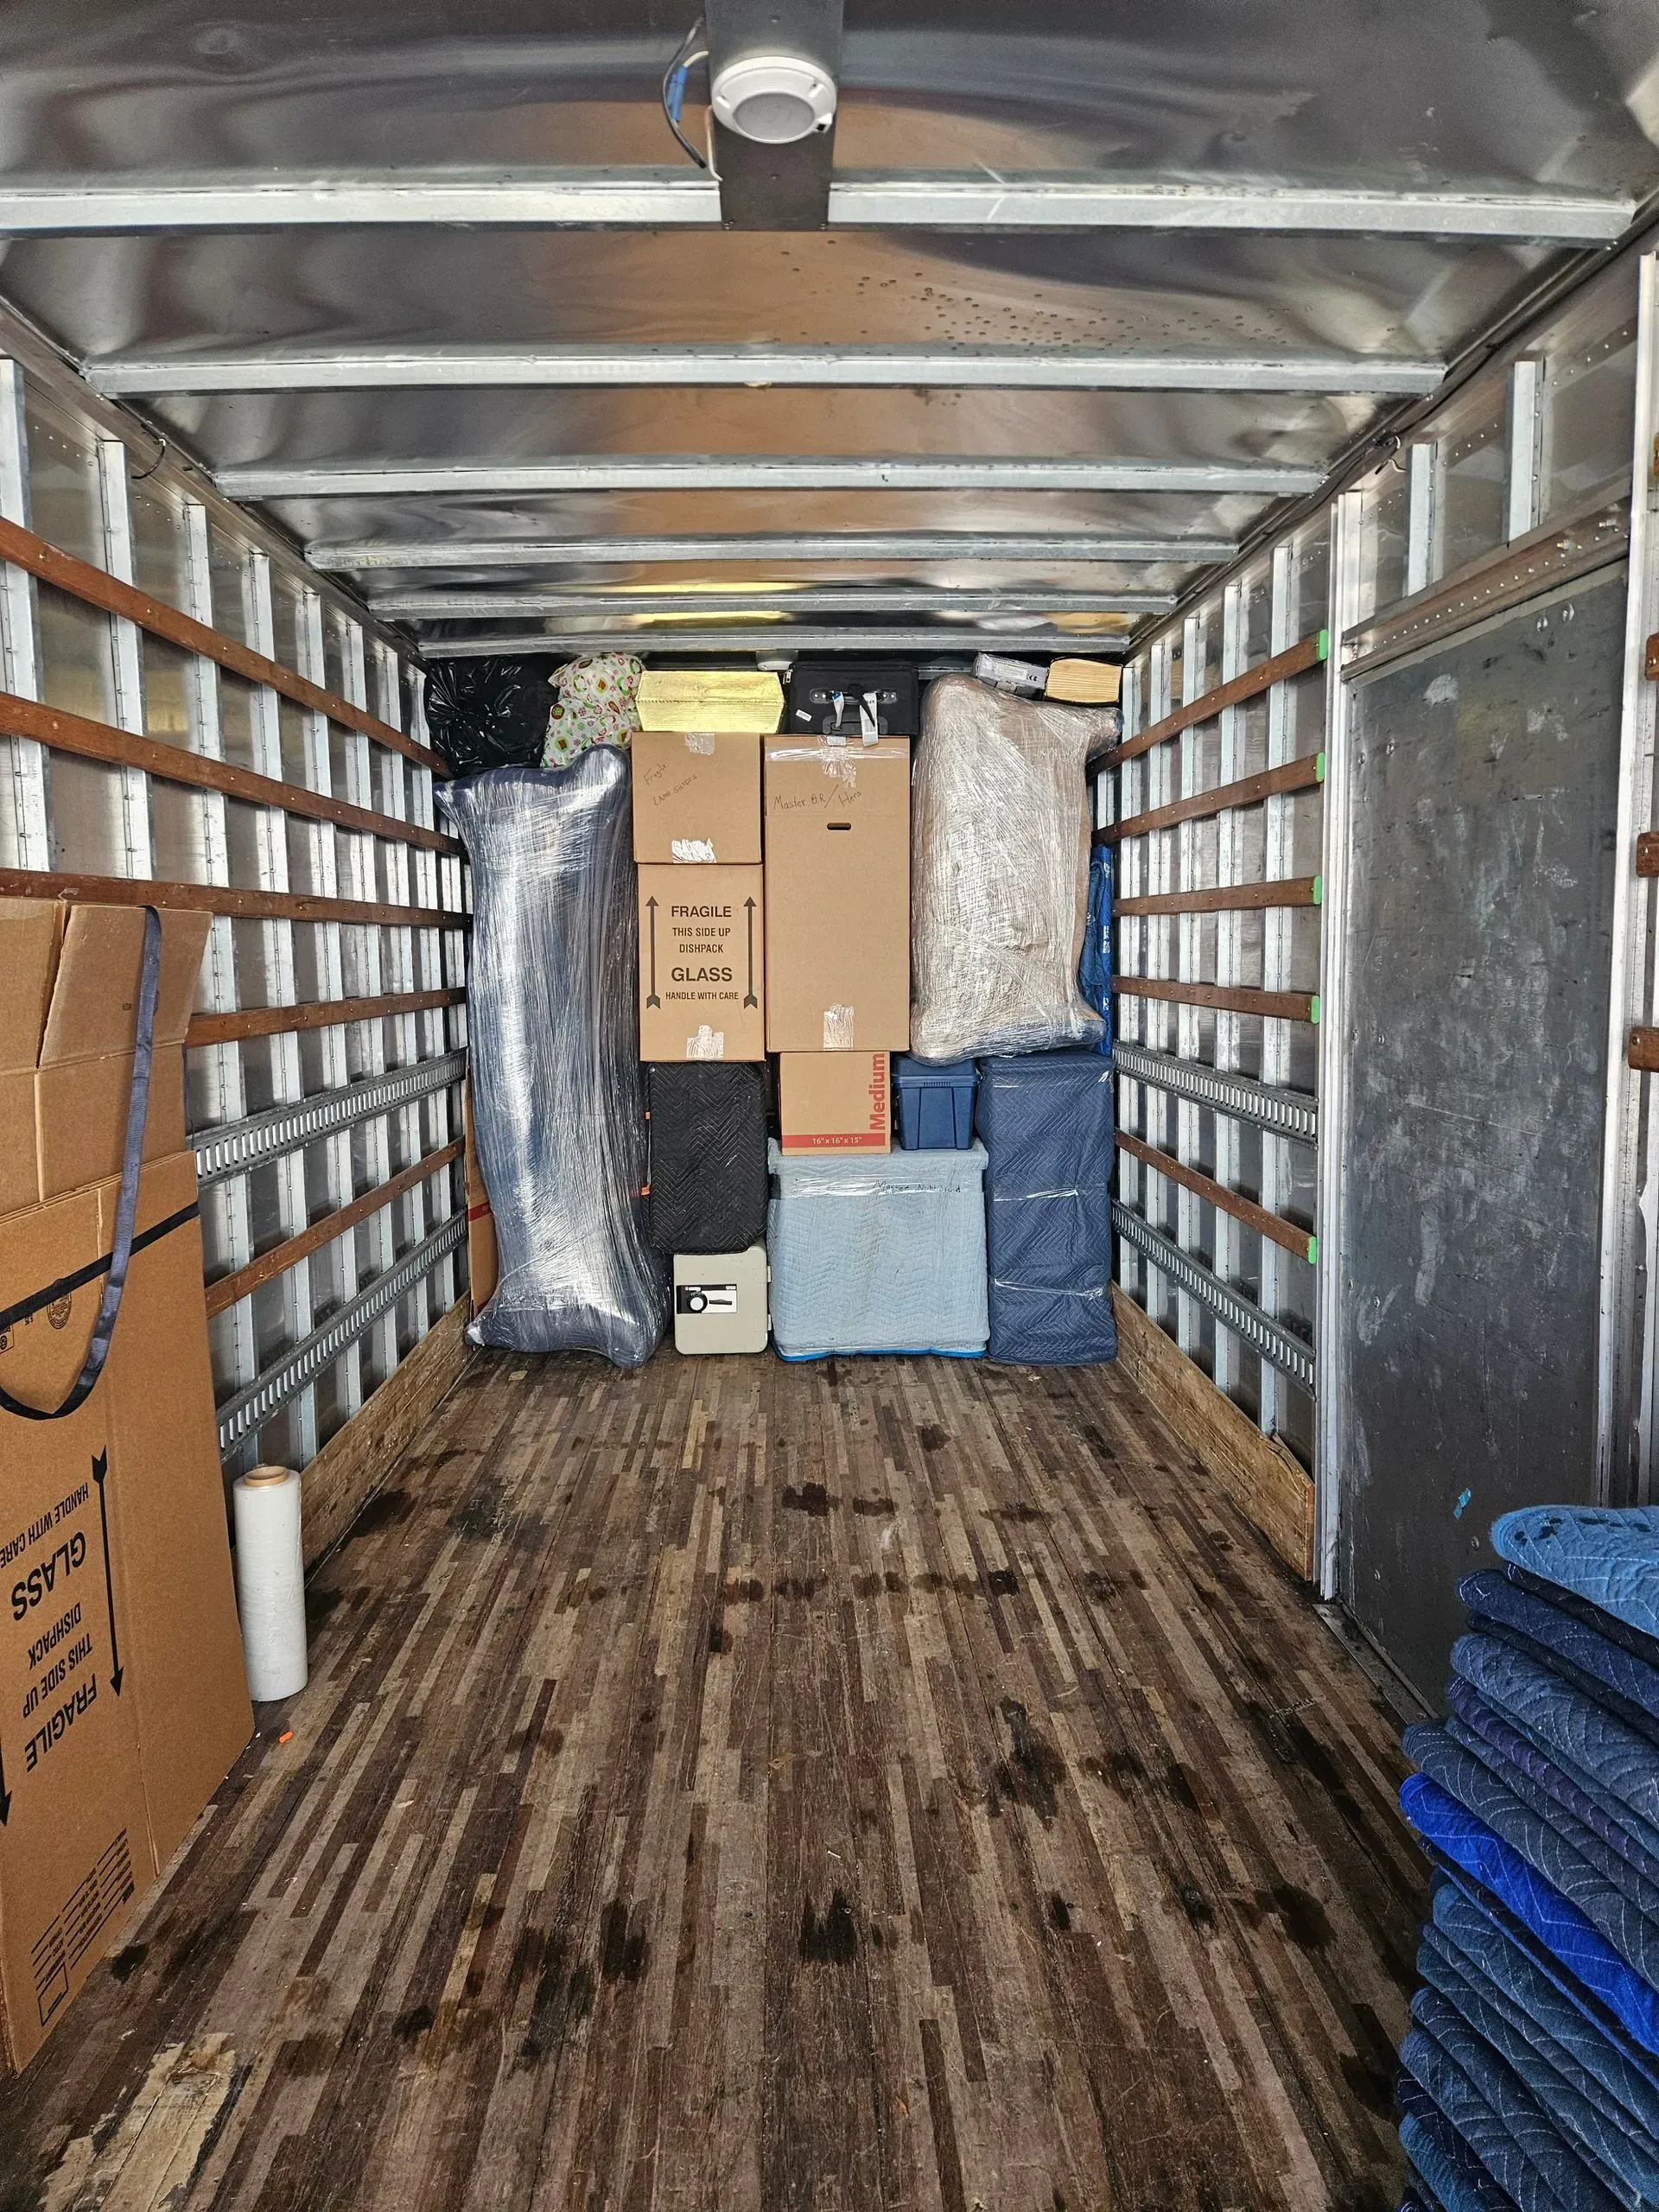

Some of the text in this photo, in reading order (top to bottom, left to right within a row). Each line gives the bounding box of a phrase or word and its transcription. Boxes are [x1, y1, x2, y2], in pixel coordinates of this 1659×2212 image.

[643, 763, 668, 785] Fragile
[673, 774, 697, 793] SHADES
[773, 794, 805, 810] Master
[839, 790, 861, 807] Hers
[671, 906, 732, 918] FRAGILE
[671, 927, 731, 937] THIS SIDE UP
[679, 944, 724, 953] DISHPACK
[671, 967, 733, 982] GLASS
[868, 1053, 886, 1130] Medium
[0, 1482, 89, 1569] HANDLE WITH CARE
[11, 1531, 86, 1621] GLASS
[28, 1601, 82, 1670] DISHPACK
[22, 1633, 92, 1719] THIS SIDE UP
[24, 1673, 98, 1773] FRAGILE
